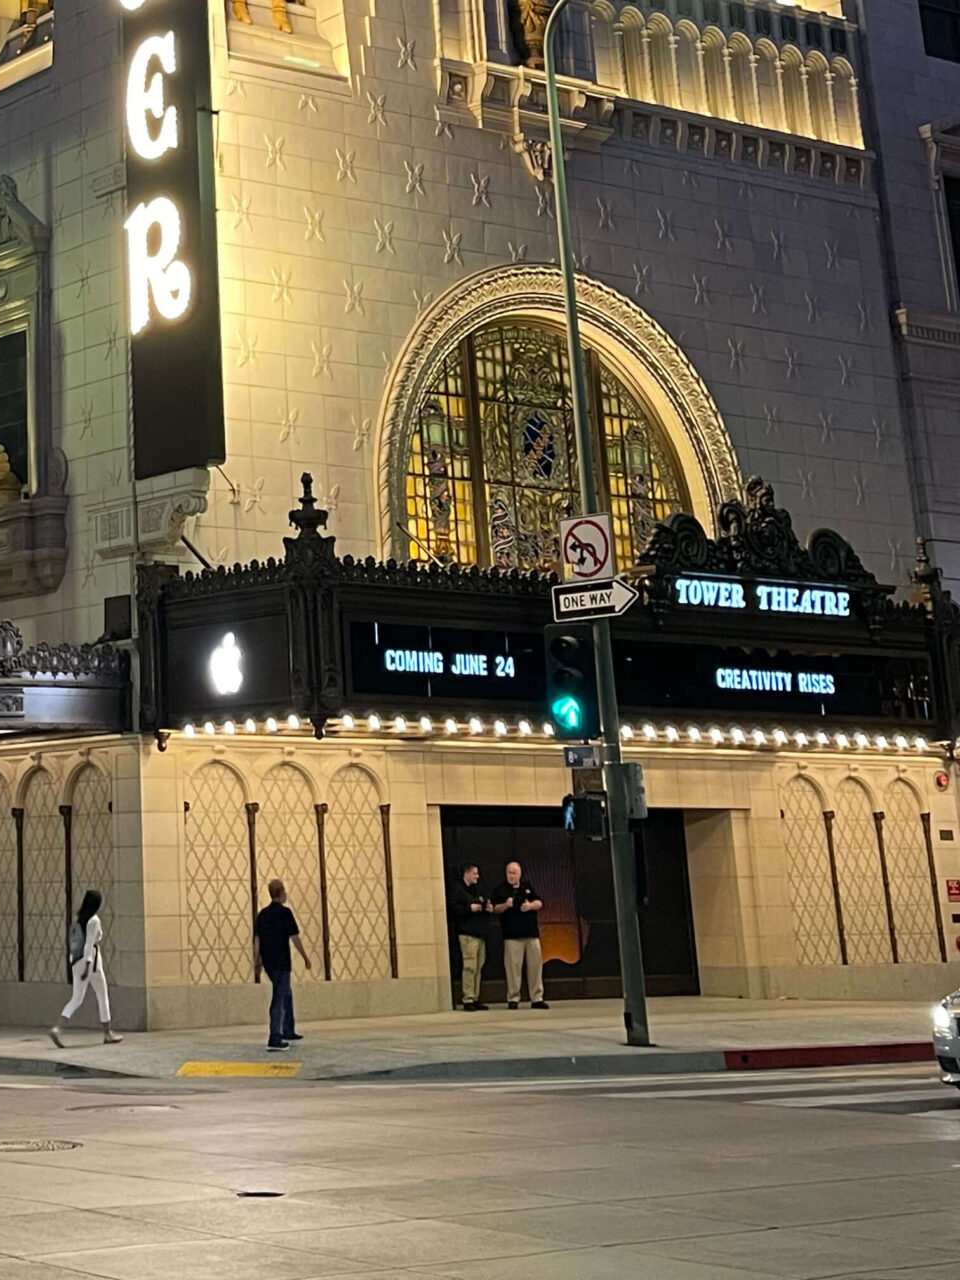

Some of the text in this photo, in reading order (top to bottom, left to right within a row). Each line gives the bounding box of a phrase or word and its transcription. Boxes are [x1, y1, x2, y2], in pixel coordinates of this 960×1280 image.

[563, 591, 613, 609] ONE WAY
[675, 578, 850, 617] TOWER THEATRE
[385, 649, 515, 677] COMING JUNE 24
[716, 668, 836, 695] CREATIVITY RISES
